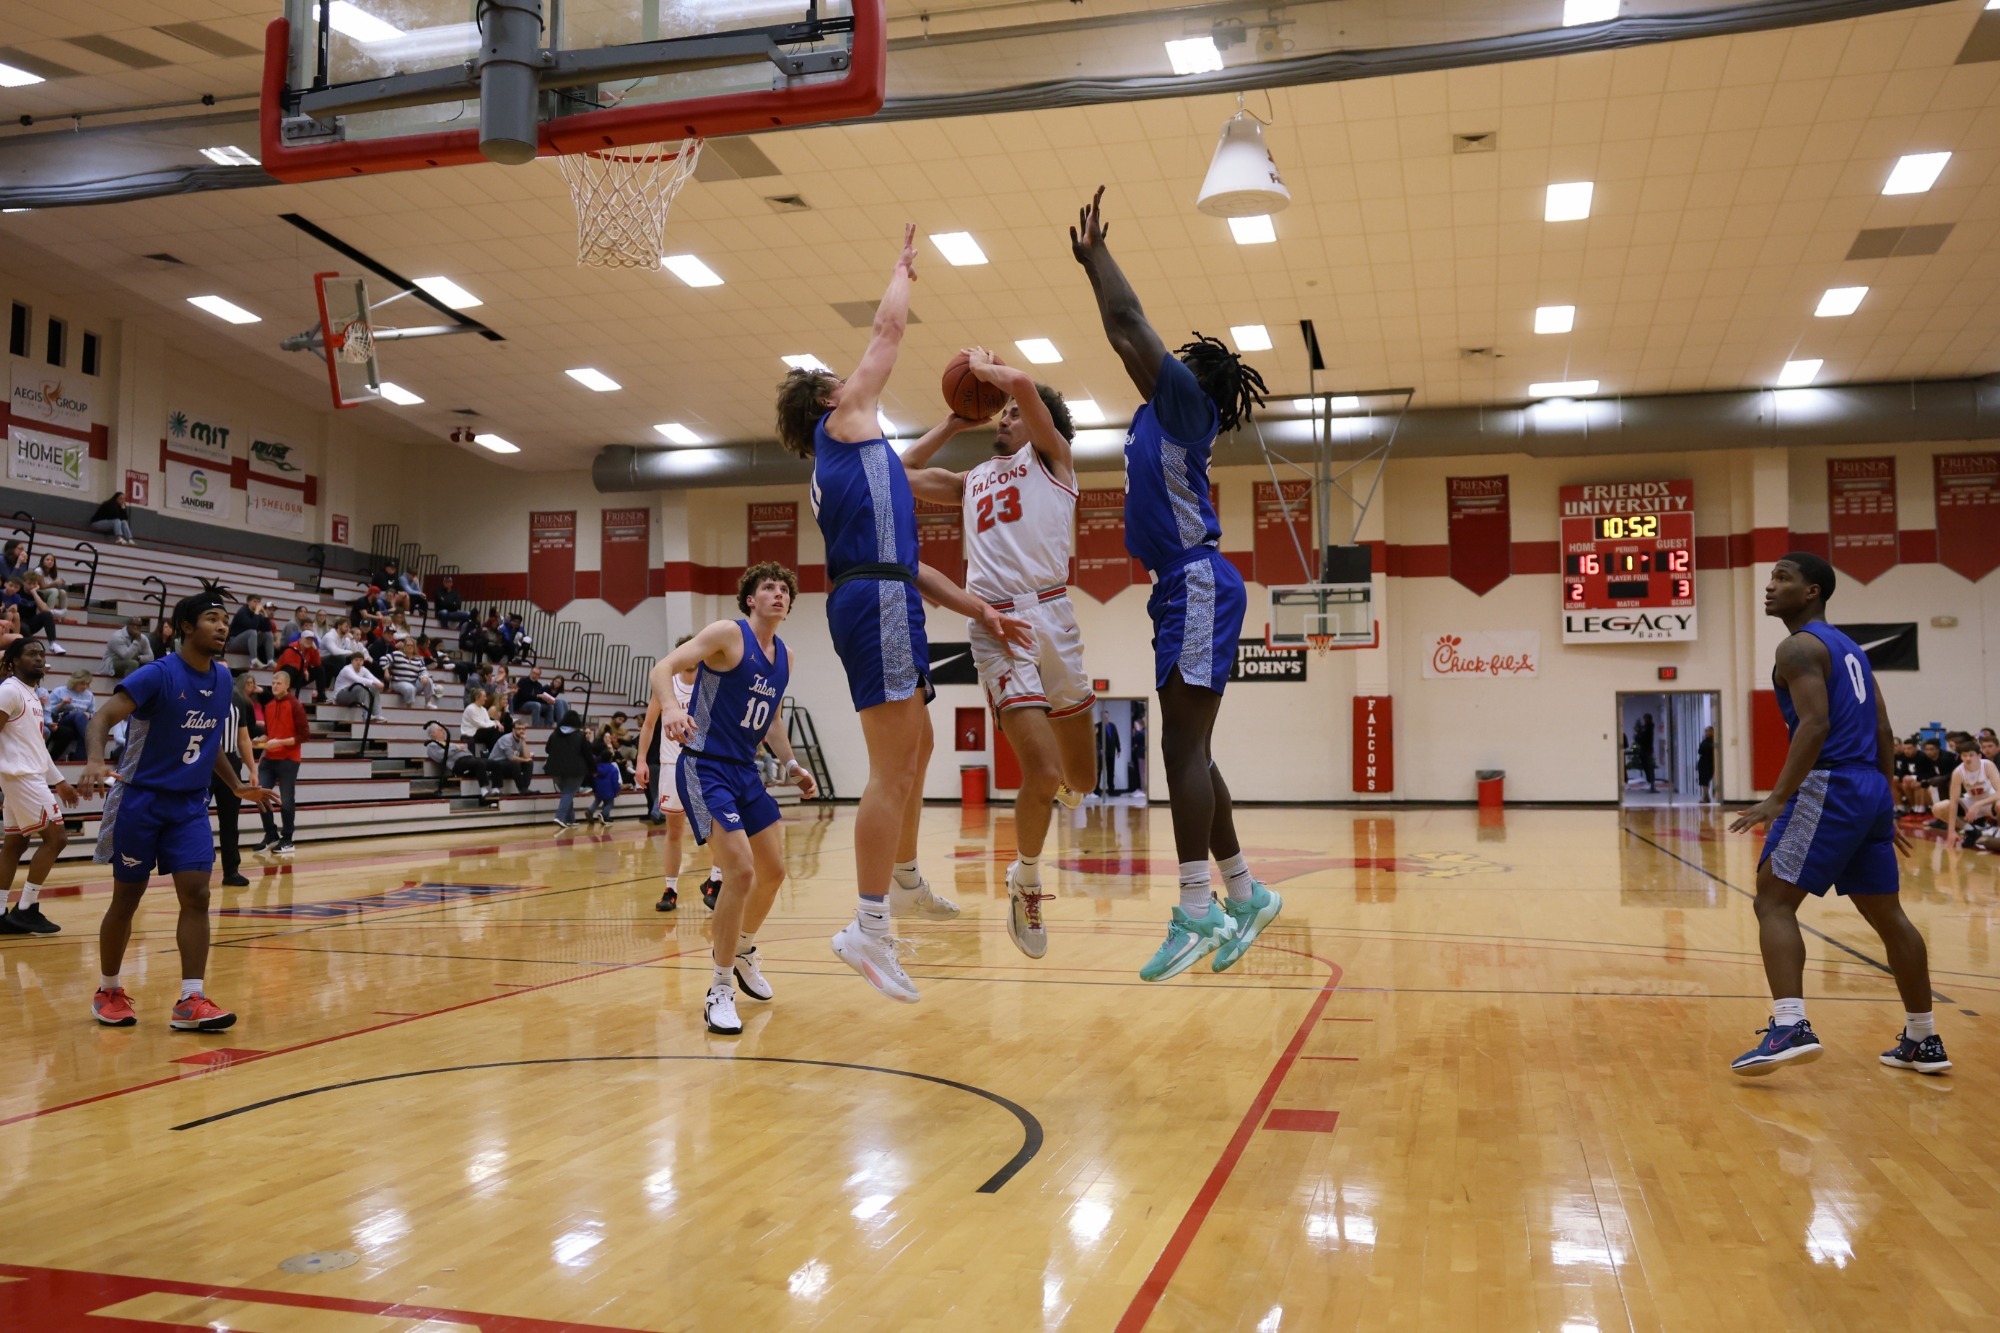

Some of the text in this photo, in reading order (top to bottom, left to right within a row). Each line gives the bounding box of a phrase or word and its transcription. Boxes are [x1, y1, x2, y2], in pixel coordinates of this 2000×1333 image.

[14, 386, 43, 403] AEGIS
[56, 397, 88, 413] GROUP
[18, 440, 63, 465] HOME
[132, 481, 143, 499] D
[972, 464, 1027, 497] FALCONS
[1259, 483, 1306, 494] FRINDS
[1453, 480, 1503, 490] FRIENDS
[1583, 482, 1669, 500] FRIENDS
[181, 496, 214, 510] SANDIFER
[977, 486, 1023, 534] 23
[1565, 496, 1687, 515] UNIVERSITY
[534, 514, 572, 523] FRIENDS
[606, 512, 644, 520] FRIENDS
[338, 524, 345, 540] E
[1603, 516, 1657, 538] 10:52
[1569, 543, 1596, 552] HOME
[1656, 539, 1688, 548] GUEST
[1579, 554, 1600, 575] 16
[1626, 555, 1633, 571] 1
[1668, 550, 1689, 572] 12
[1571, 584, 1583, 600] 2
[1678, 580, 1690, 598] 3
[1566, 613, 1692, 635] LEGACY
[1639, 631, 1672, 639] Bank
[1433, 643, 1535, 676] Chick-fil-A
[1238, 661, 1302, 678] JOHN'S
[1844, 653, 1867, 704] 0
[748, 673, 776, 698] Tabor
[181, 709, 218, 729] Tabor
[740, 697, 770, 731] 10
[182, 734, 204, 765] 5
[1366, 699, 1377, 790] FALCONS
